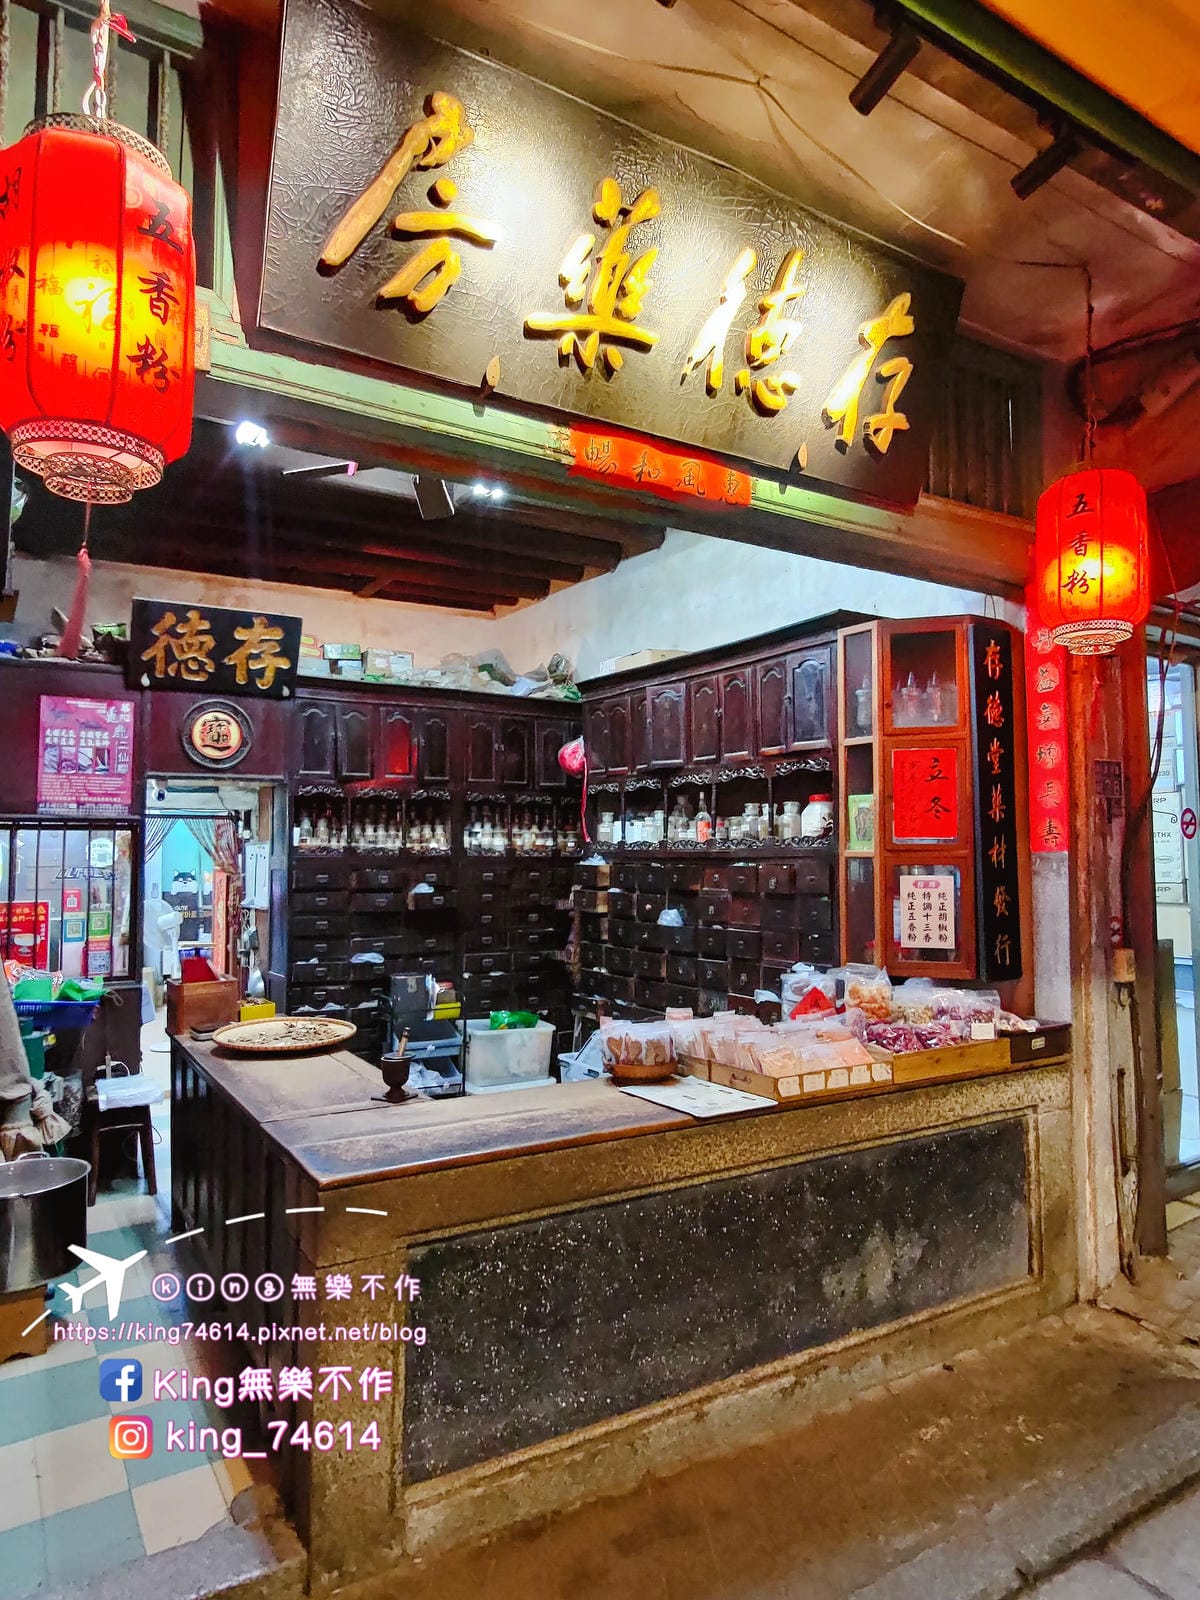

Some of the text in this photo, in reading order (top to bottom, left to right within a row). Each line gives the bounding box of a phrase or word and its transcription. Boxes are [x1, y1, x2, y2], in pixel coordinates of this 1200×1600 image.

[126, 199, 184, 392] 五香粉
[584, 439, 745, 505] 惠風和暢
[1061, 493, 1097, 595] 五香粉
[141, 609, 291, 690] 存德
[924, 757, 952, 820] 立冬
[907, 891, 917, 942] 純正五香粉
[922, 891, 932, 943] 特調十三香
[938, 891, 948, 943] 純正胡椒粉
